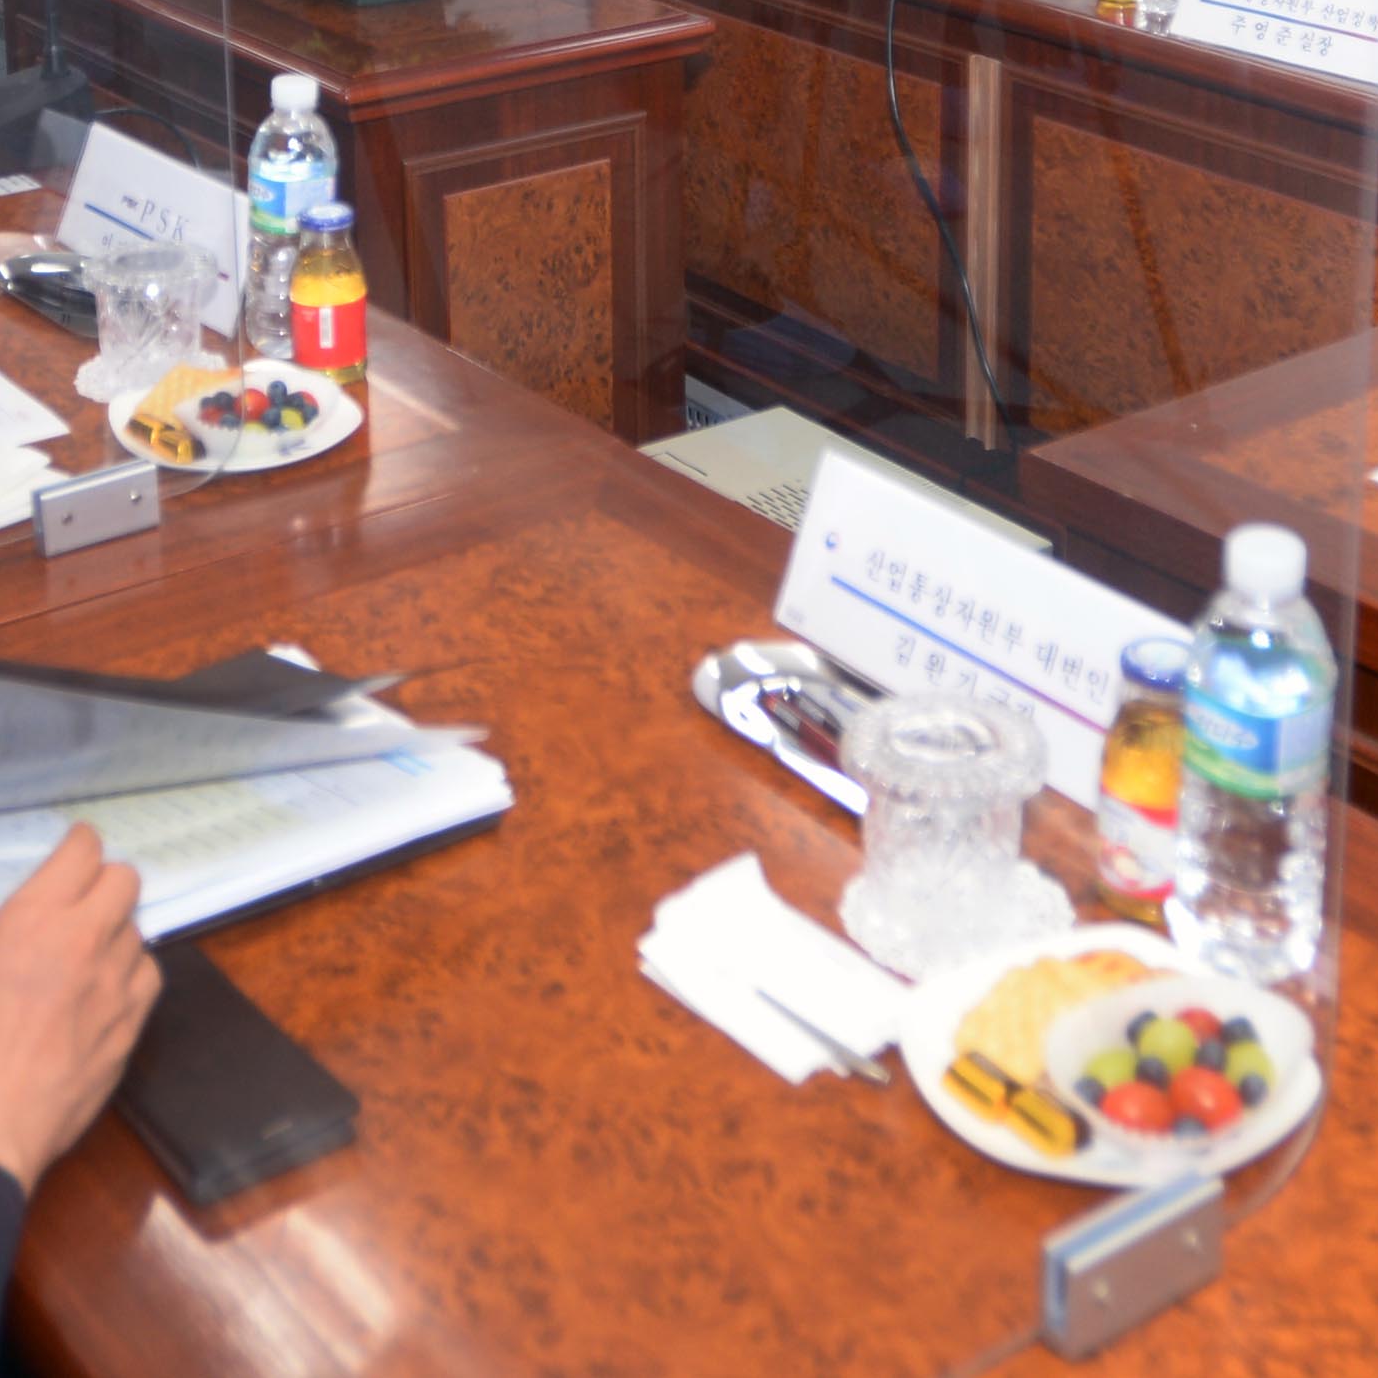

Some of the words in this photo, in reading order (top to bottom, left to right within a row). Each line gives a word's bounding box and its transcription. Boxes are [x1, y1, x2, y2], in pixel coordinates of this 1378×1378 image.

[140, 198, 190, 243] PSK
[865, 549, 1025, 655] 산업통상자원부
[1036, 641, 1110, 706] 대변인
